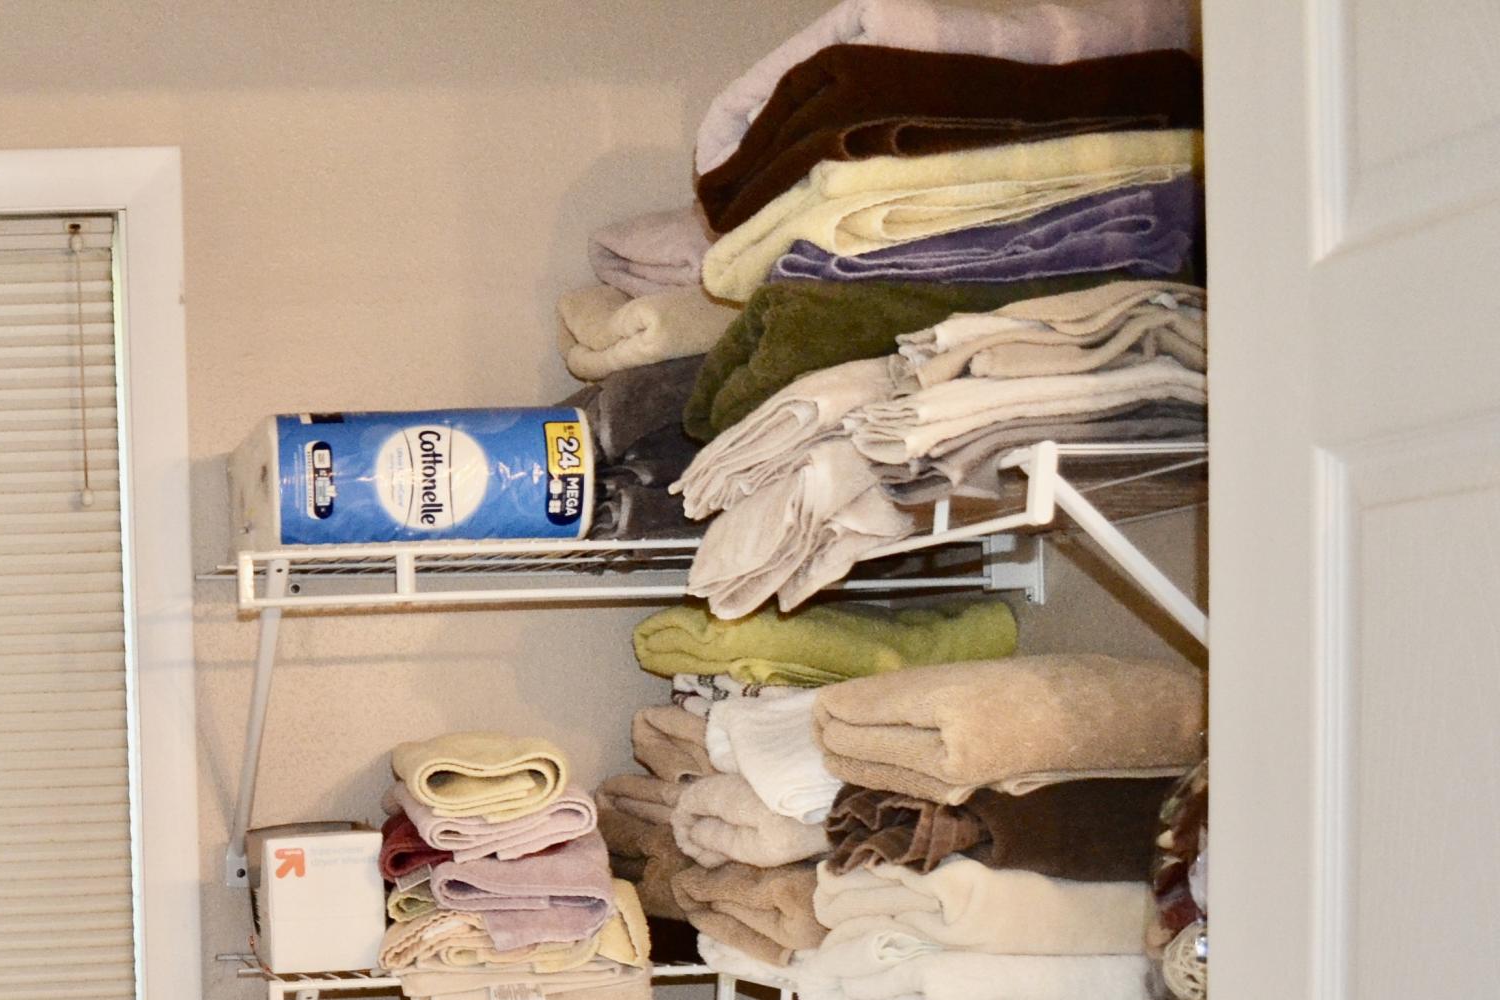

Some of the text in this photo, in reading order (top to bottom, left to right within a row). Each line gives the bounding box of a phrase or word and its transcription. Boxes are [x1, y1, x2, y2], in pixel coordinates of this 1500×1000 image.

[557, 437, 580, 470] 24
[418, 430, 444, 525] Cottonelle
[564, 477, 580, 516] MEGA
